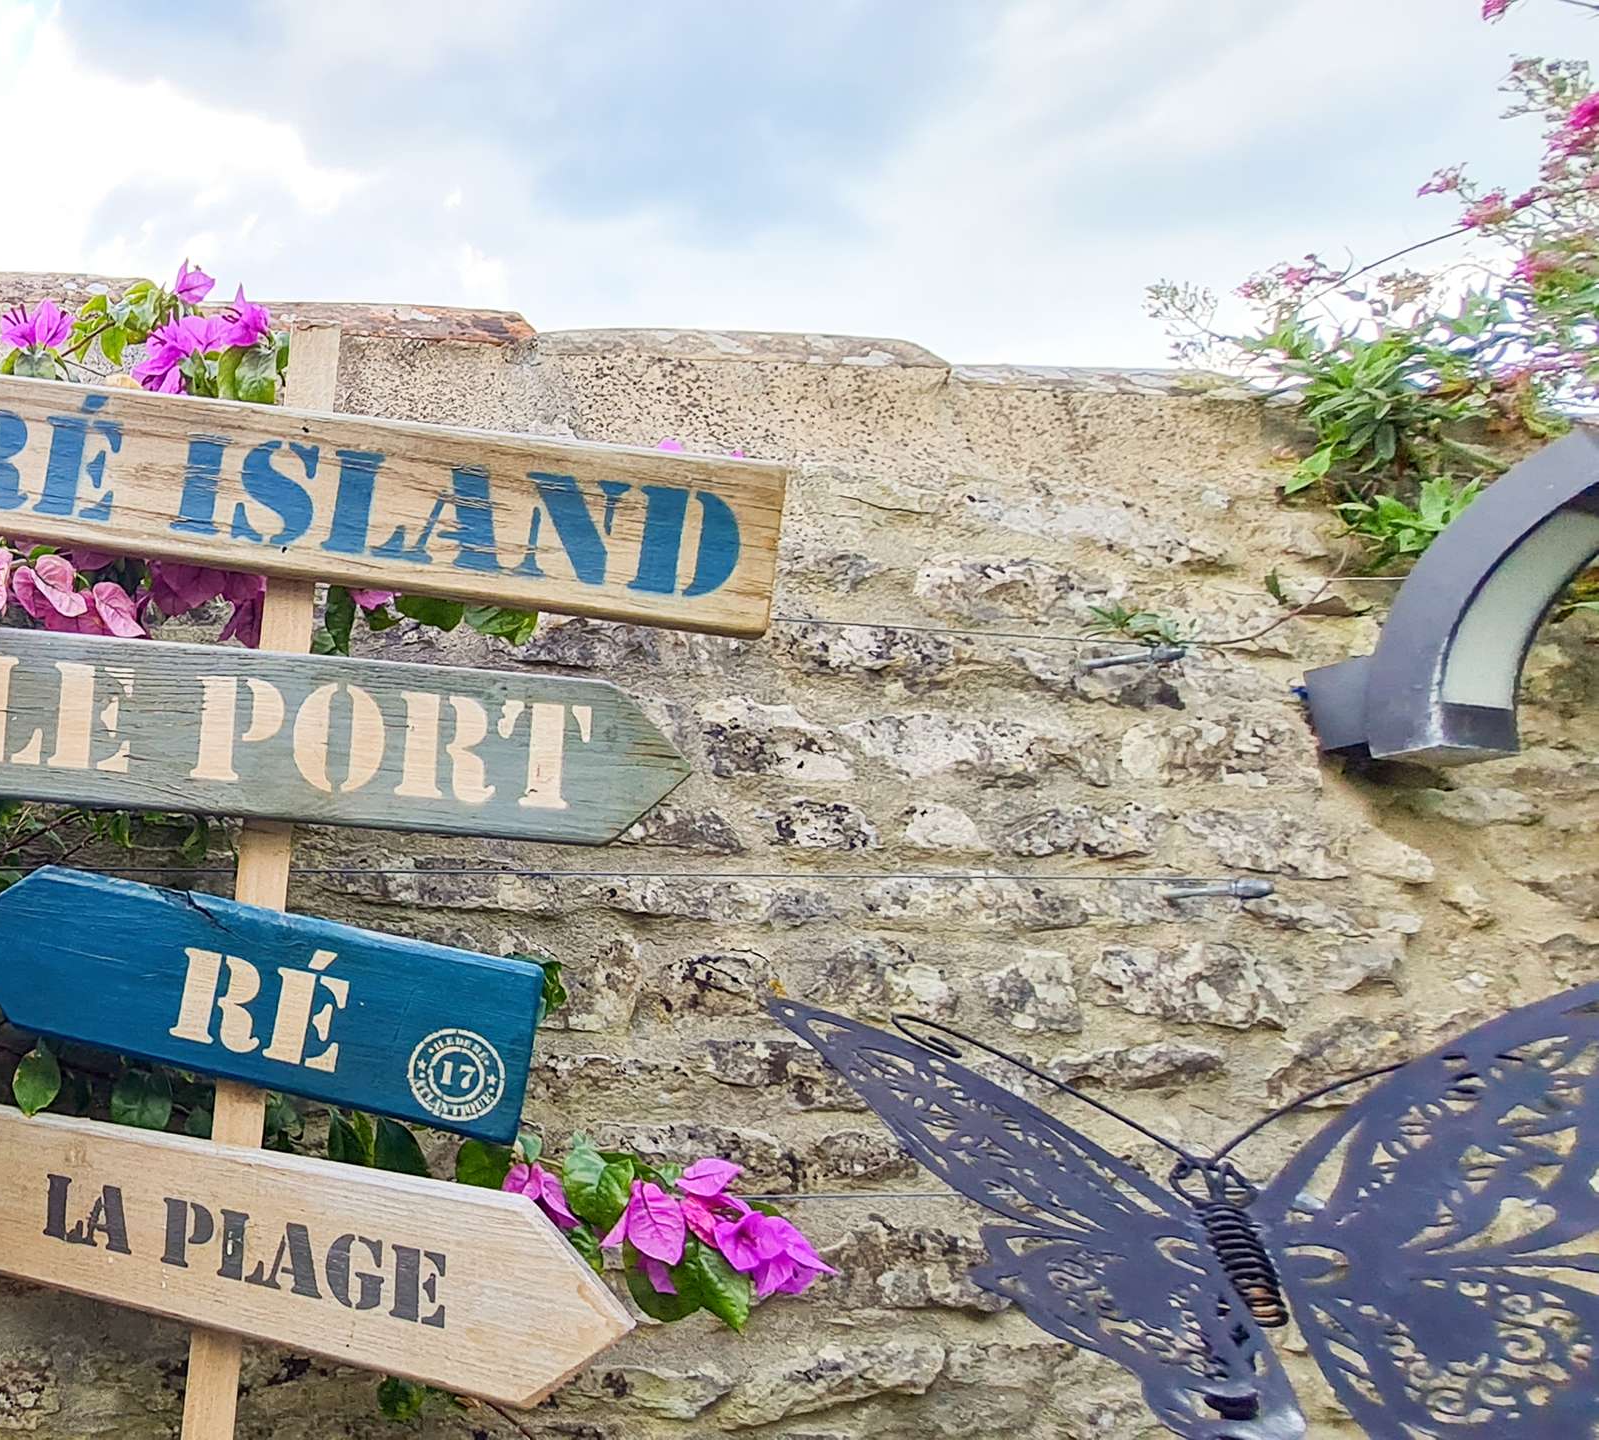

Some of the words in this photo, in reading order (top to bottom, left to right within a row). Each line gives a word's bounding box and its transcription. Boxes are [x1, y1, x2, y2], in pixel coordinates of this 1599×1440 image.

[170, 434, 740, 597] ISLAND
[189, 675, 592, 809] PORT
[169, 948, 351, 1072] RÉ
[440, 1060, 476, 1089] 17
[43, 1173, 131, 1254] LA
[161, 1197, 446, 1328] PLAGE
